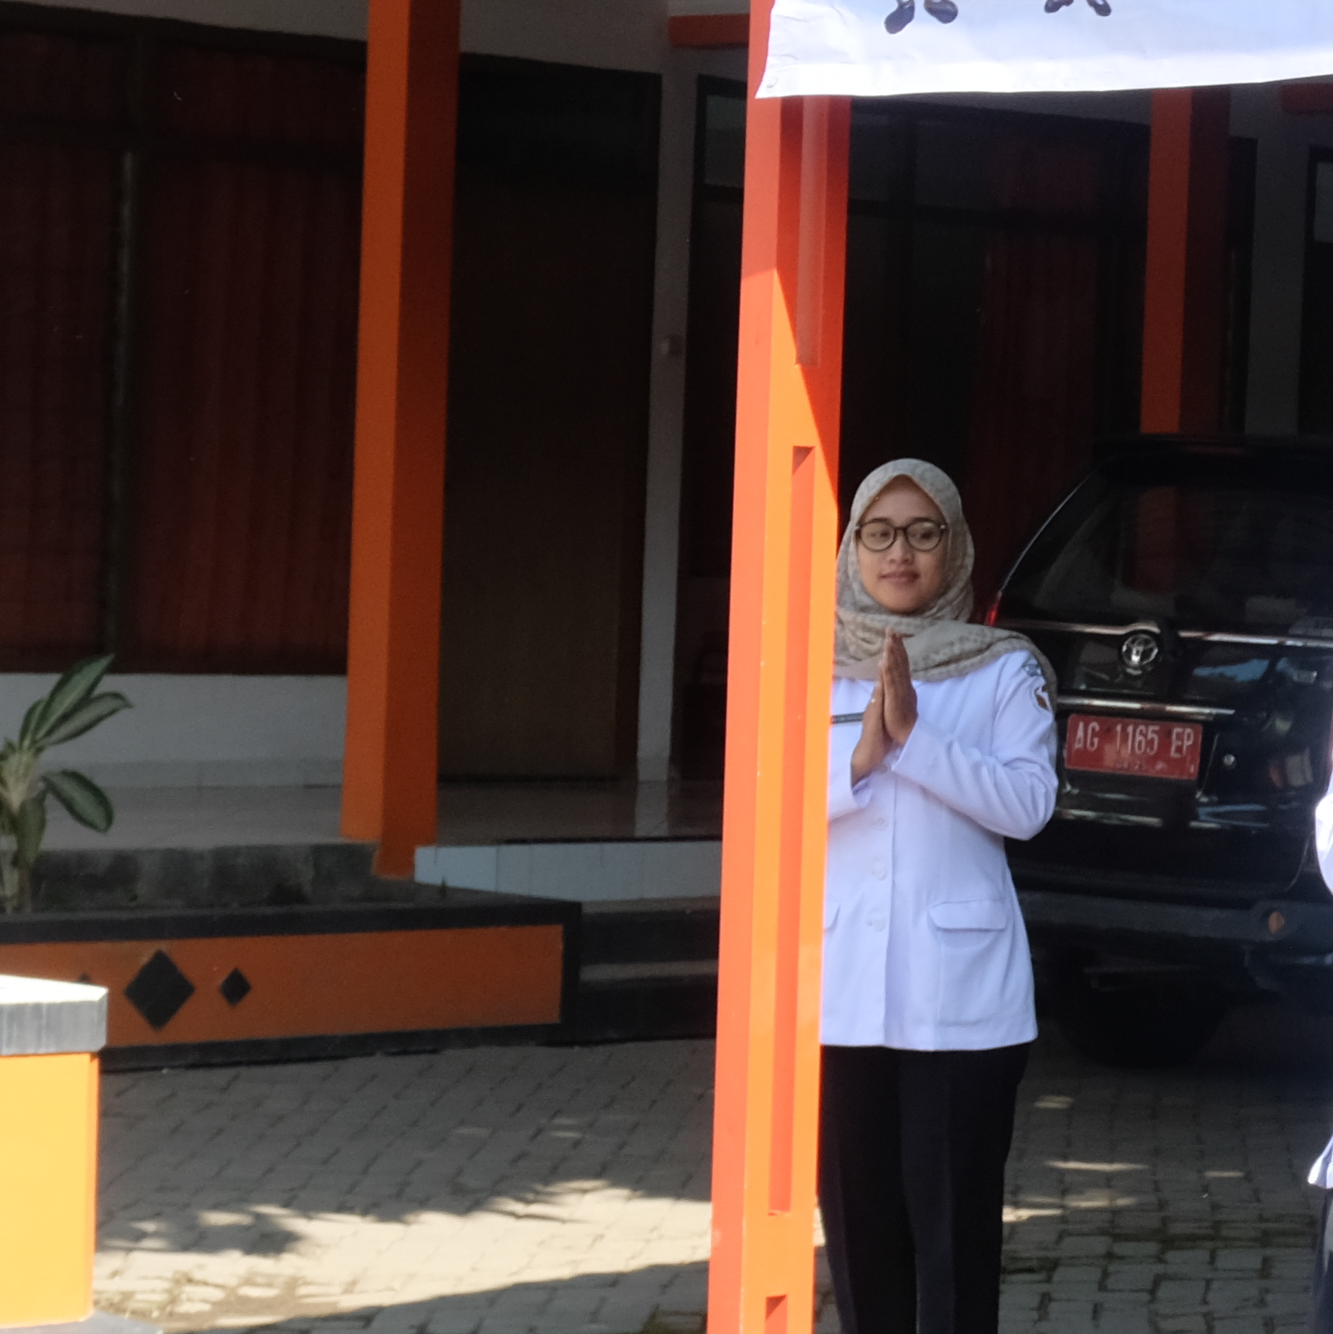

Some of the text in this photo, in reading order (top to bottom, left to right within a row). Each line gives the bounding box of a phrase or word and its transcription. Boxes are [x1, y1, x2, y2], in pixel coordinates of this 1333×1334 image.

[1074, 721, 1195, 758] AG 1165 EP
